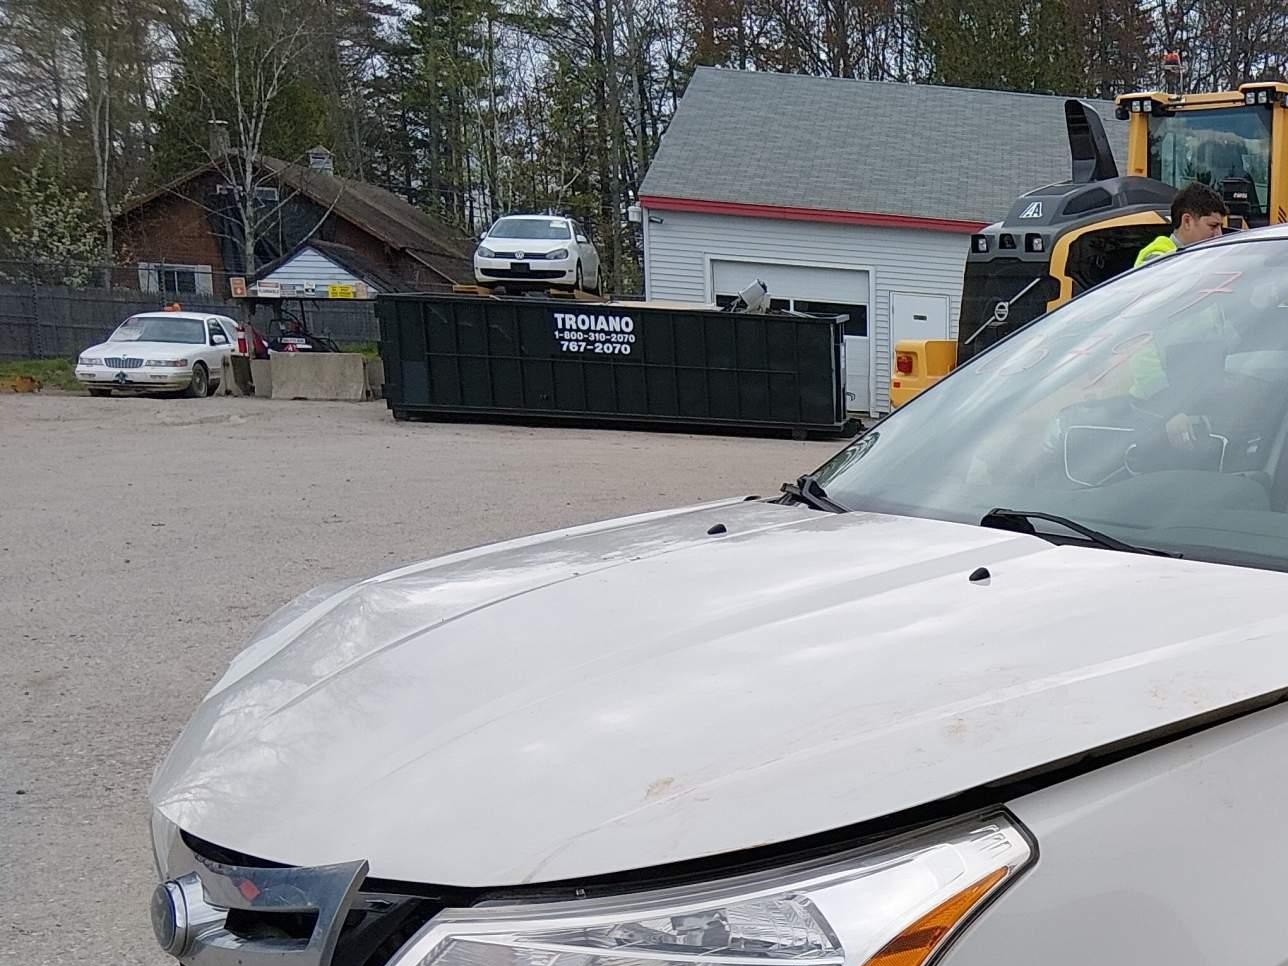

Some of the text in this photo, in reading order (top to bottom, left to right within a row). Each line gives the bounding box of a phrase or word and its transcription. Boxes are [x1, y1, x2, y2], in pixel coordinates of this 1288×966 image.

[553, 313, 634, 332] TROIANO
[554, 330, 636, 343] 1-800-310-2070
[560, 341, 631, 354] 767-2070
